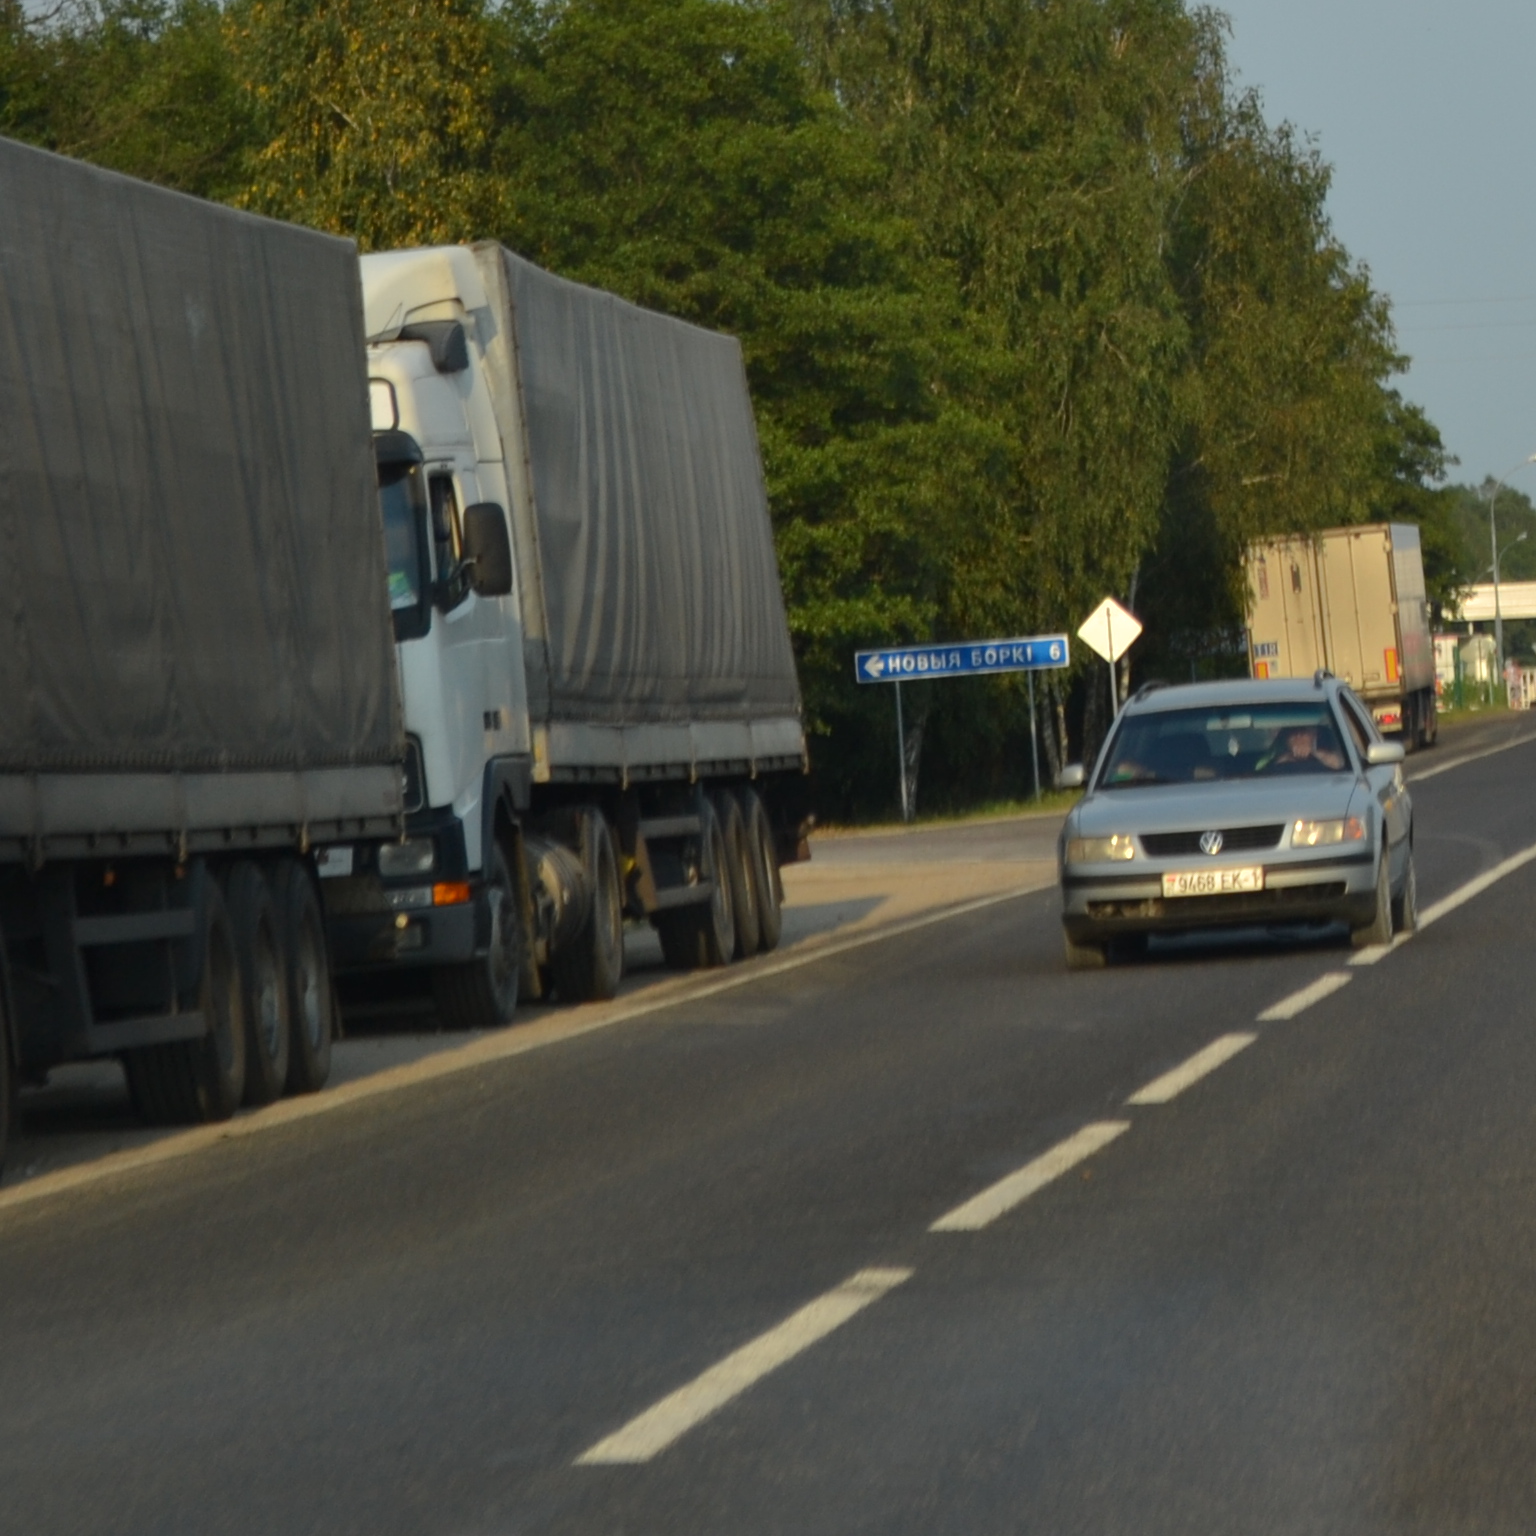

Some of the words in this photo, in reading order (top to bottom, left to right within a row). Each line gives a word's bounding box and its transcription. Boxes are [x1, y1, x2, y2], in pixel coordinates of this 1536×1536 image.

[888, 650, 961, 674] НОВЫЯ
[971, 644, 1033, 668] БОРКІ
[1049, 641, 1061, 662] 6
